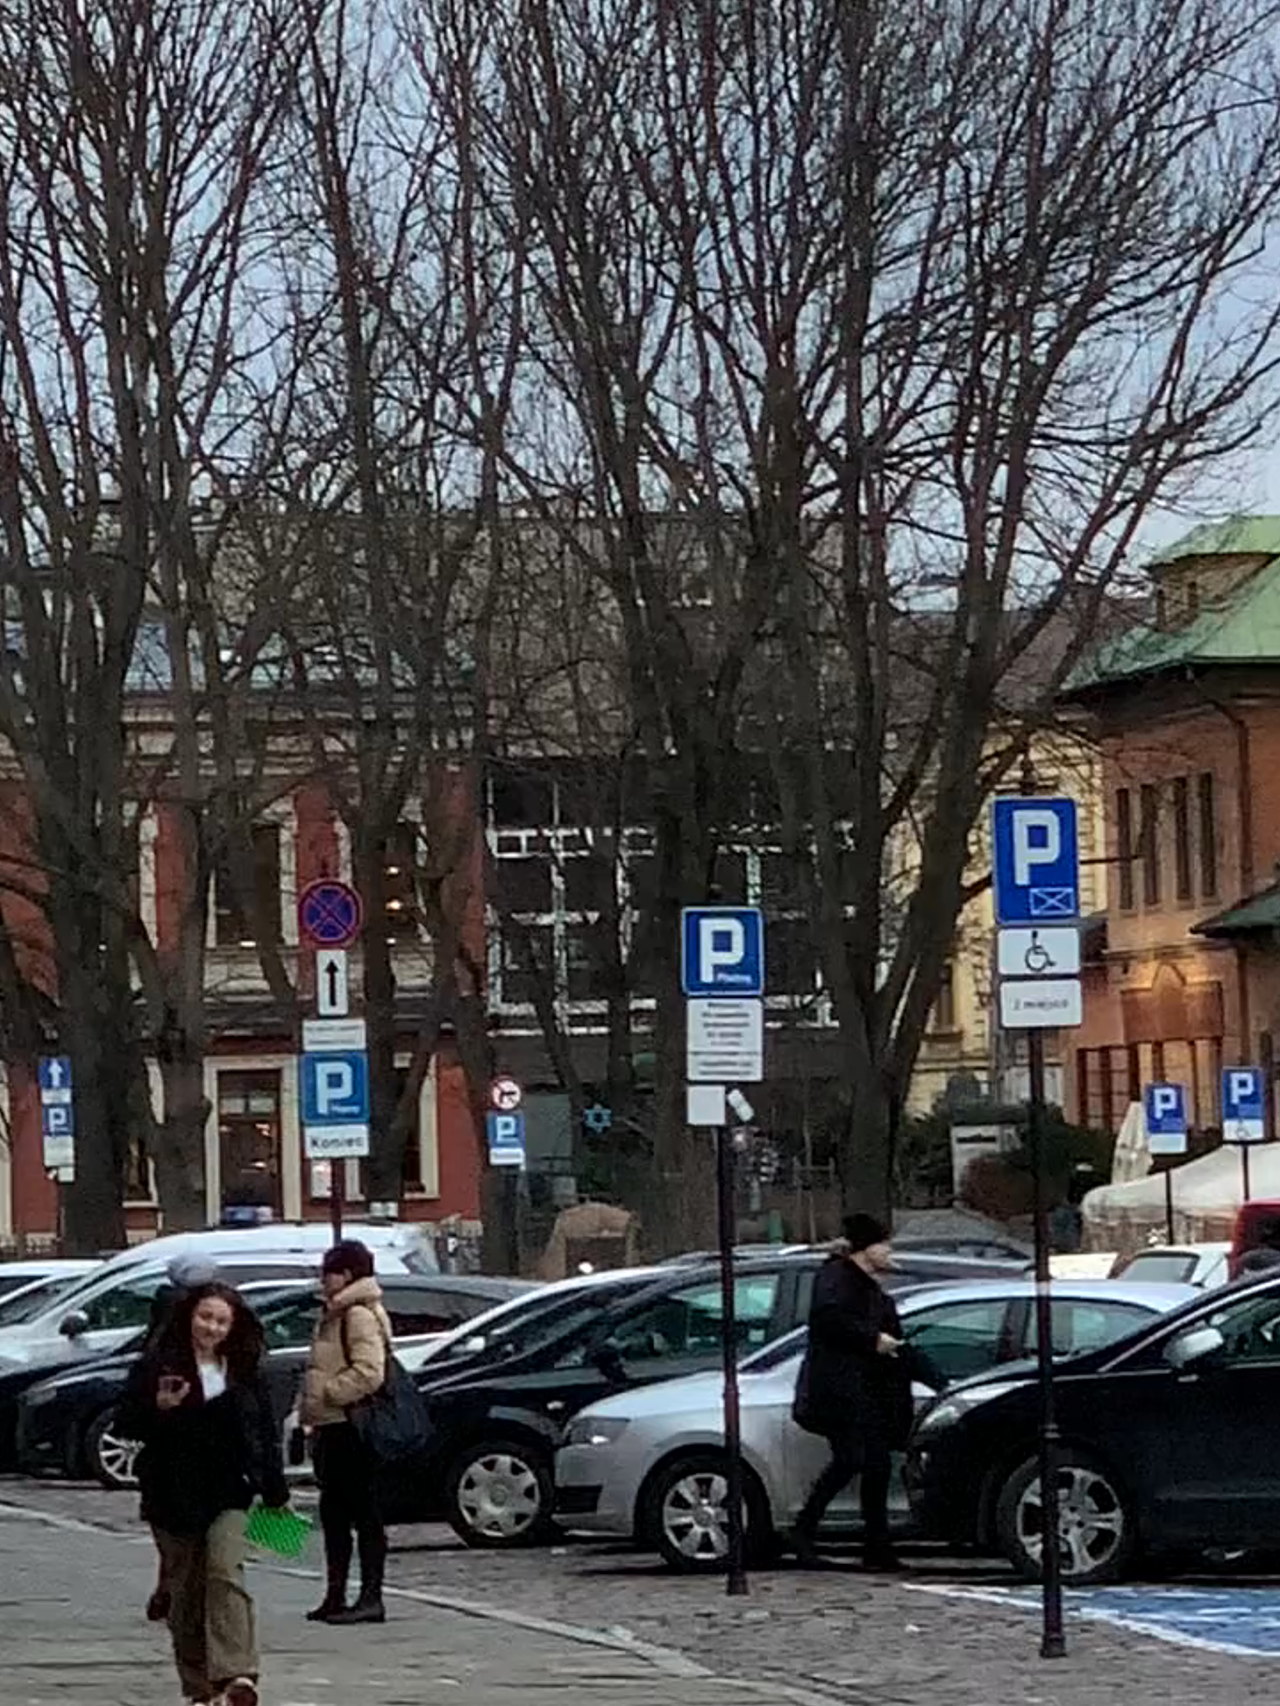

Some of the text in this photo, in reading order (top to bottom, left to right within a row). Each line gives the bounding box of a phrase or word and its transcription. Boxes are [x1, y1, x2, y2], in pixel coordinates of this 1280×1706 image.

[1012, 809, 1060, 885] P
[700, 918, 744, 983] P
[315, 1062, 353, 1114] P
[1153, 1087, 1177, 1120] P
[1230, 1072, 1254, 1104] P
[48, 1107, 67, 1133] P
[496, 1116, 516, 1143] P
